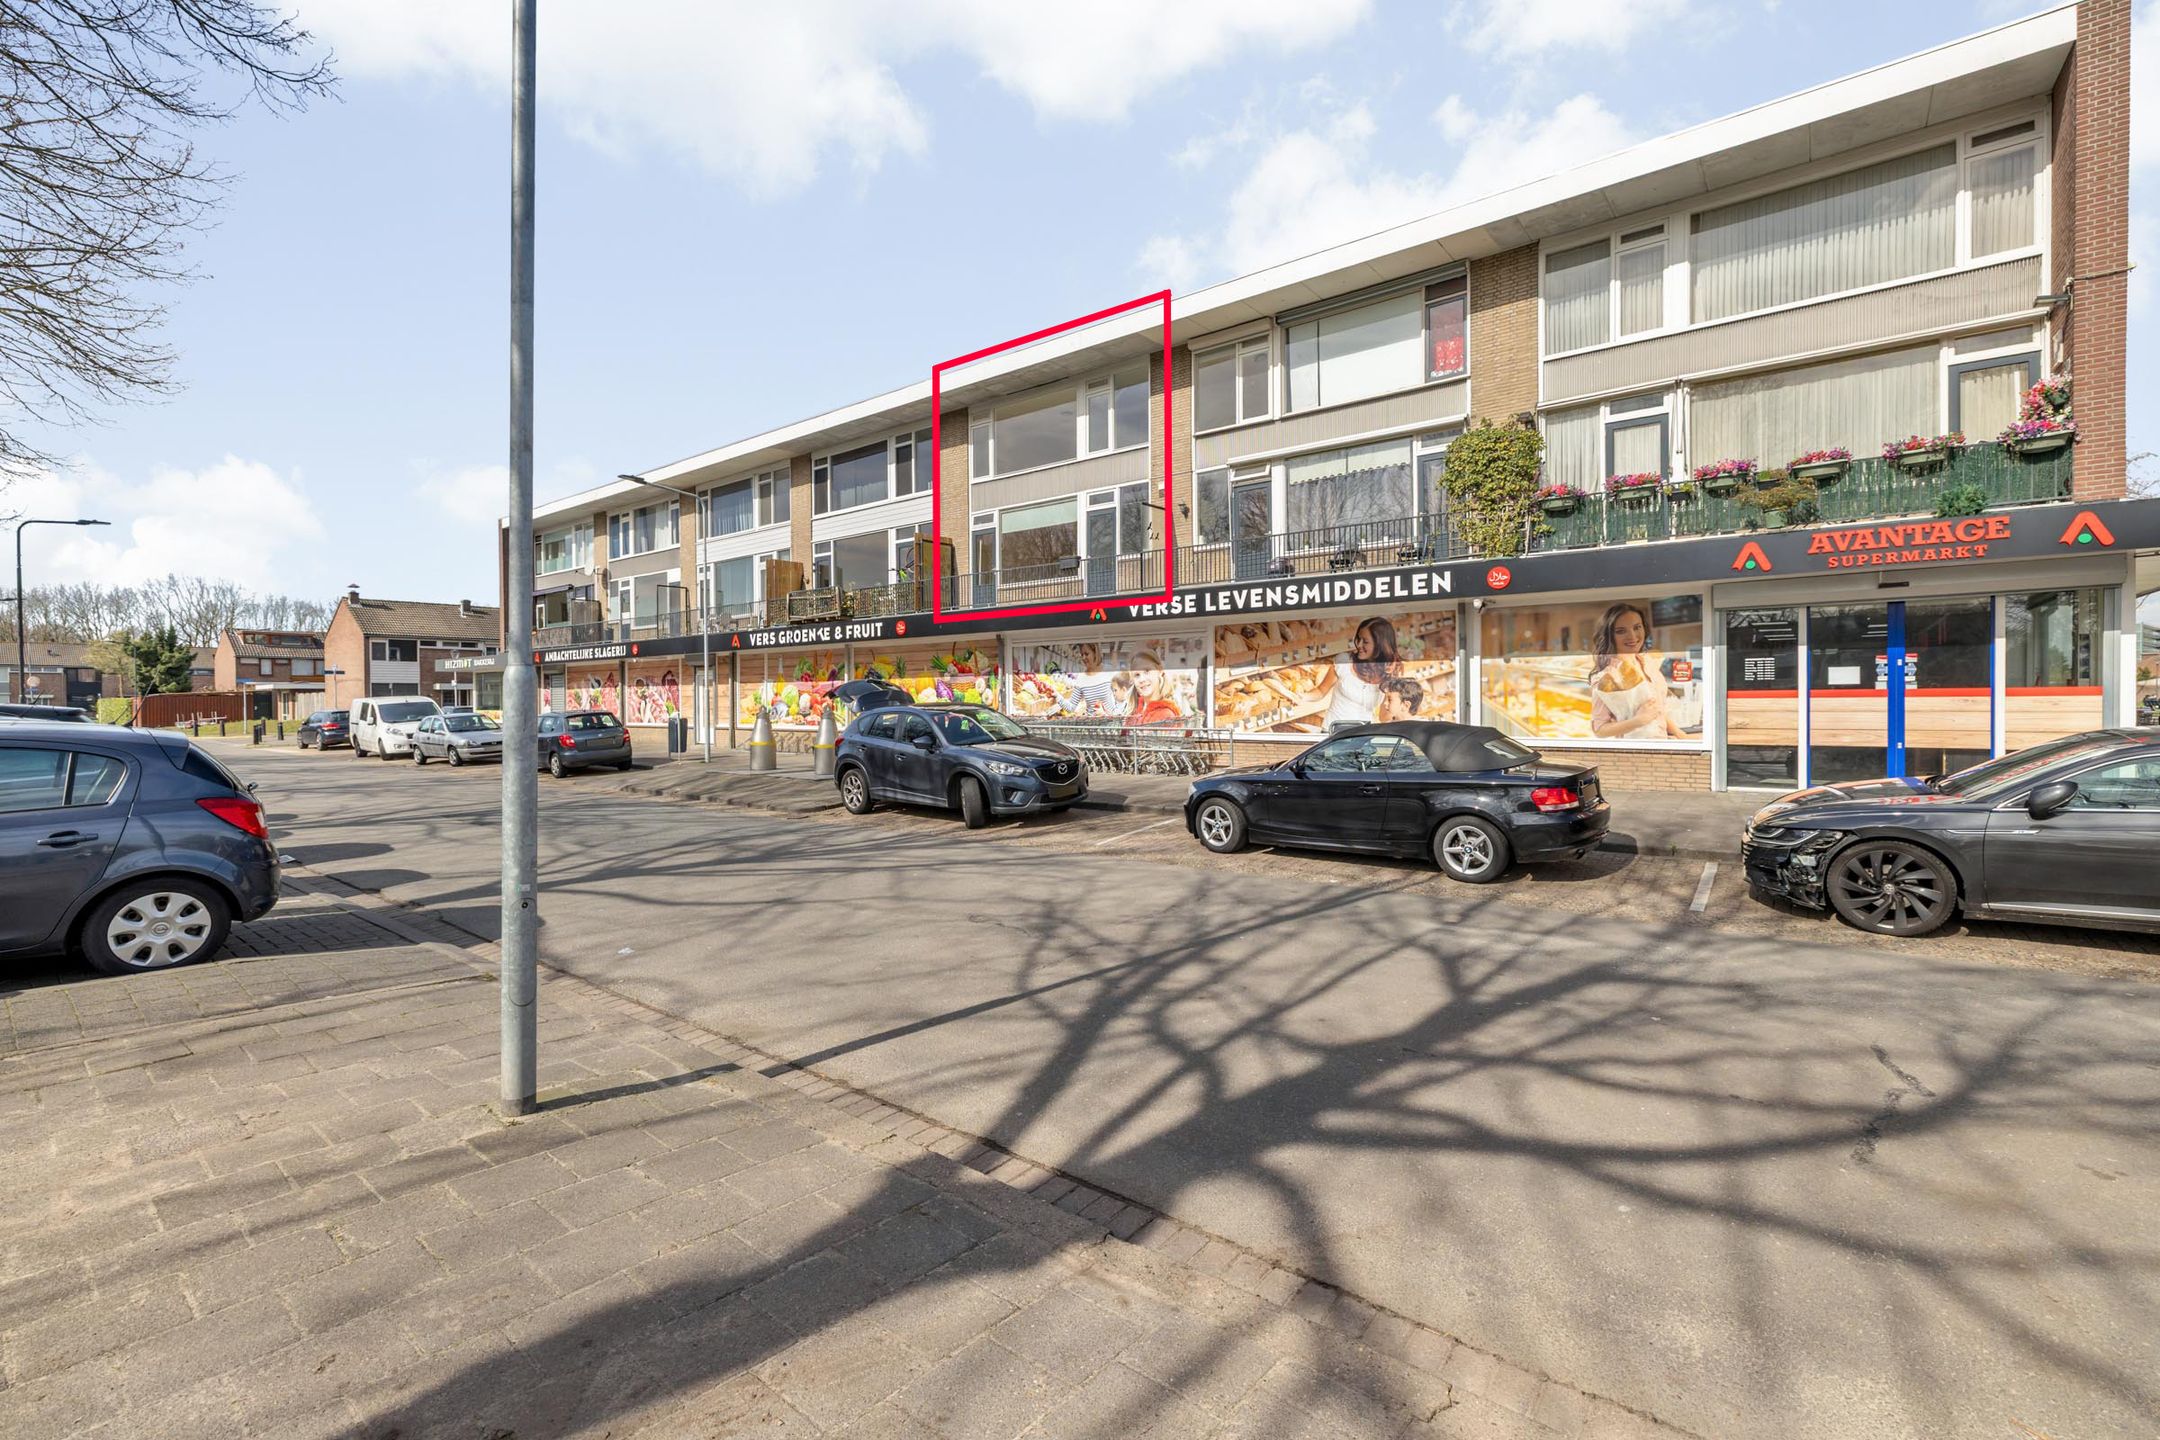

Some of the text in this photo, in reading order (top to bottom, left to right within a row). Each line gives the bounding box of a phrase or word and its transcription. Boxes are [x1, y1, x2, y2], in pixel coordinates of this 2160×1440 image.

[1808, 516, 2010, 554] AVANTAGE
[1828, 544, 1988, 568] SUPERMARKT
[1129, 571, 1451, 618] VERSE LEVENSMIDDELEN
[750, 631, 776, 647] VERS
[779, 627, 831, 644] GROENTE
[834, 625, 843, 640] &
[846, 622, 884, 639] FRUIT
[544, 645, 627, 662] AMBACHTELIJKE SLAGERIJ
